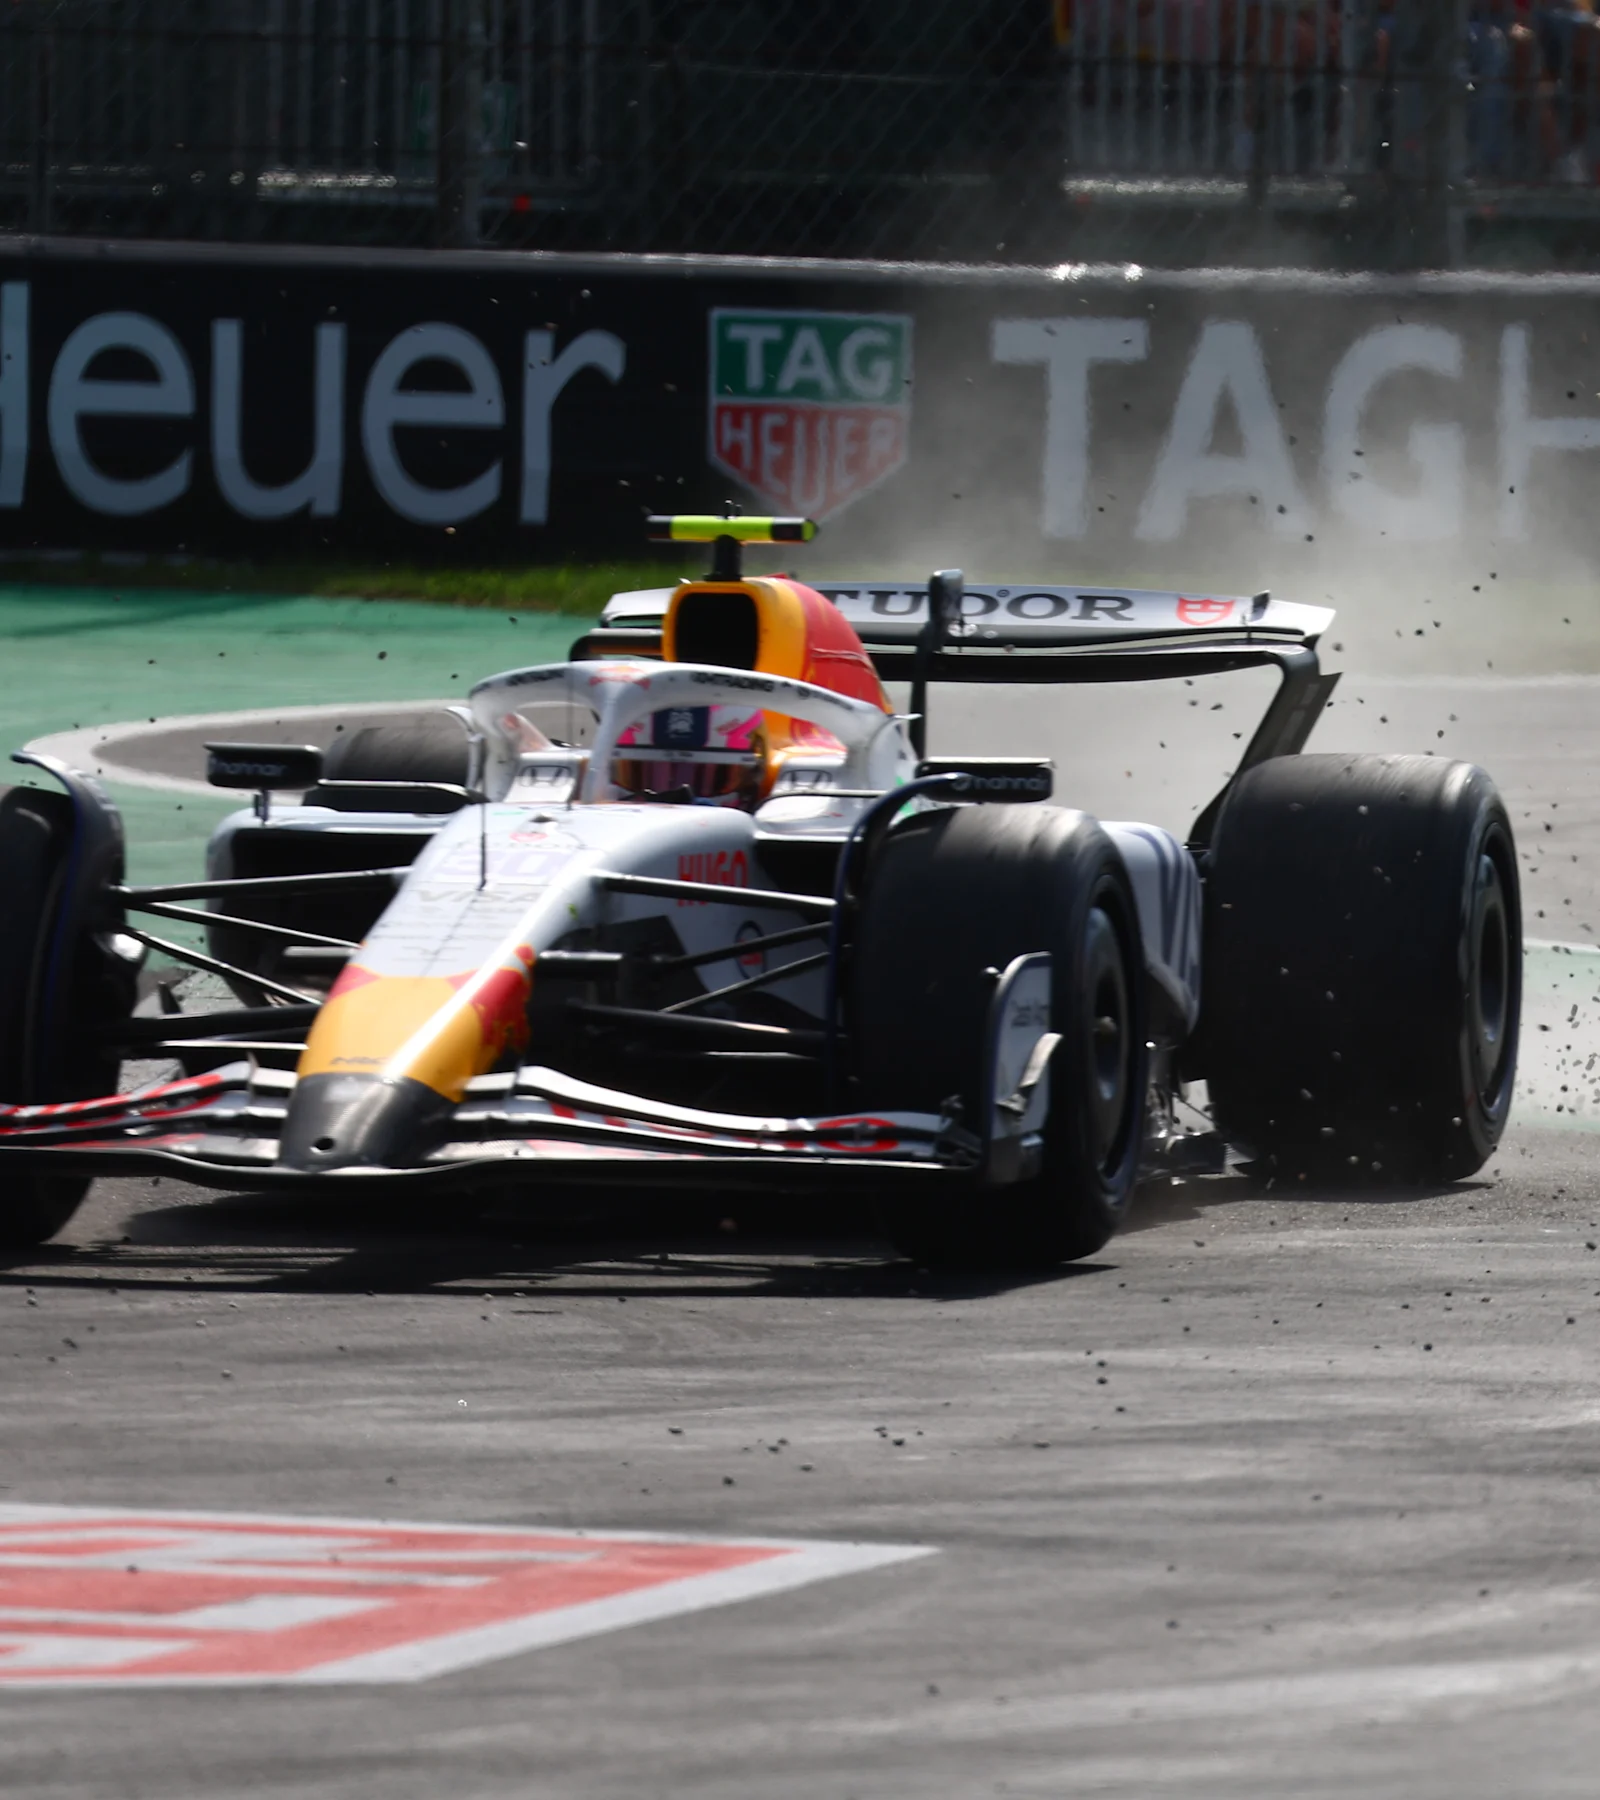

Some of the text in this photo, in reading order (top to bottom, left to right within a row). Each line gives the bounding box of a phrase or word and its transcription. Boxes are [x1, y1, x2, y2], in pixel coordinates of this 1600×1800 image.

[727, 325, 896, 396] TAG
[720, 413, 902, 508] HEUER
[678, 849, 749, 907] HUGO
